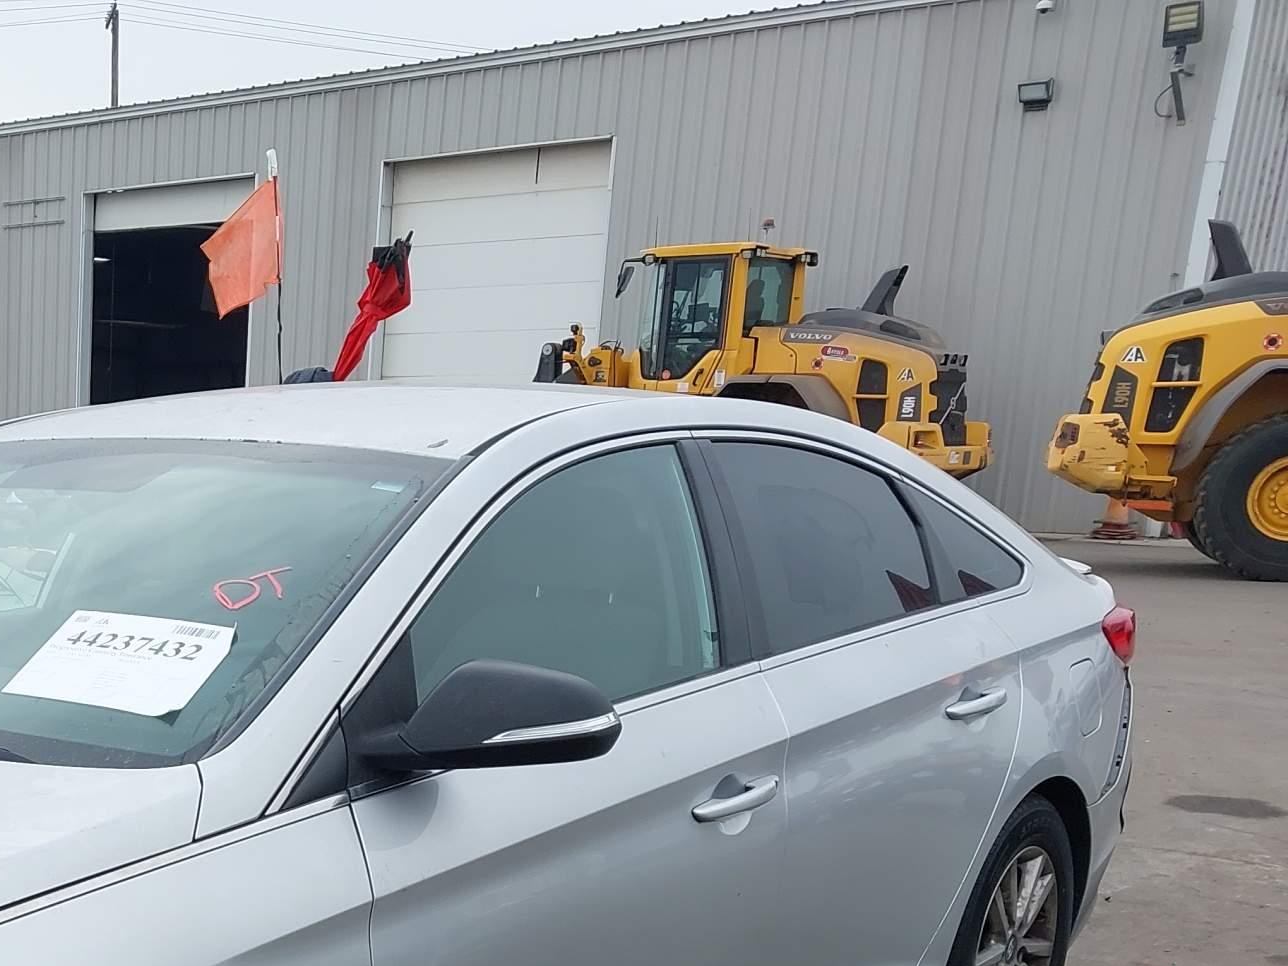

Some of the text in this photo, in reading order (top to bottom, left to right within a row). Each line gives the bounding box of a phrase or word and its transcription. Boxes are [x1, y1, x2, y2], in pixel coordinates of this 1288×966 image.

[789, 332, 833, 341] VOLVO
[901, 396, 916, 419] L90H
[1113, 381, 1132, 409] L90H
[66, 629, 204, 661] 44237432
